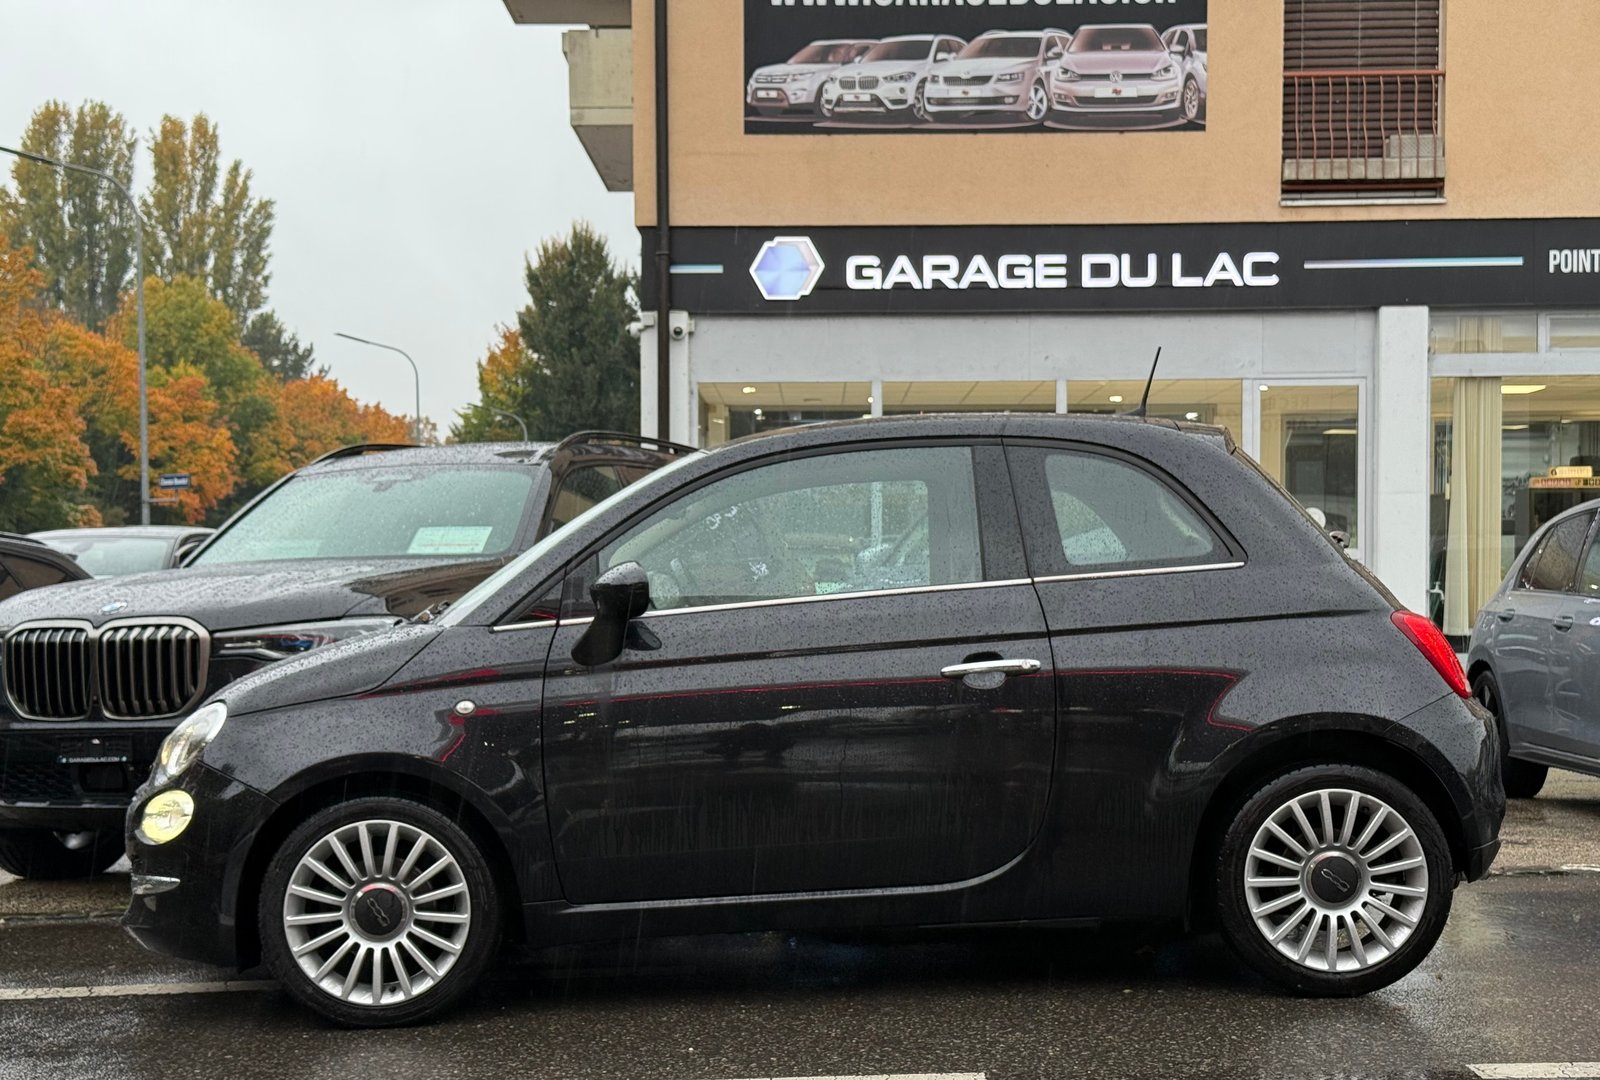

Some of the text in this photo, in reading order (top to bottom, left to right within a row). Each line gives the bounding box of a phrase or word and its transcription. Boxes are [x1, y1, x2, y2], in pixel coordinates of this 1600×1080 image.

[846, 252, 1279, 289] GARAGE DU LAC
[1549, 249, 1600, 273] POINT
